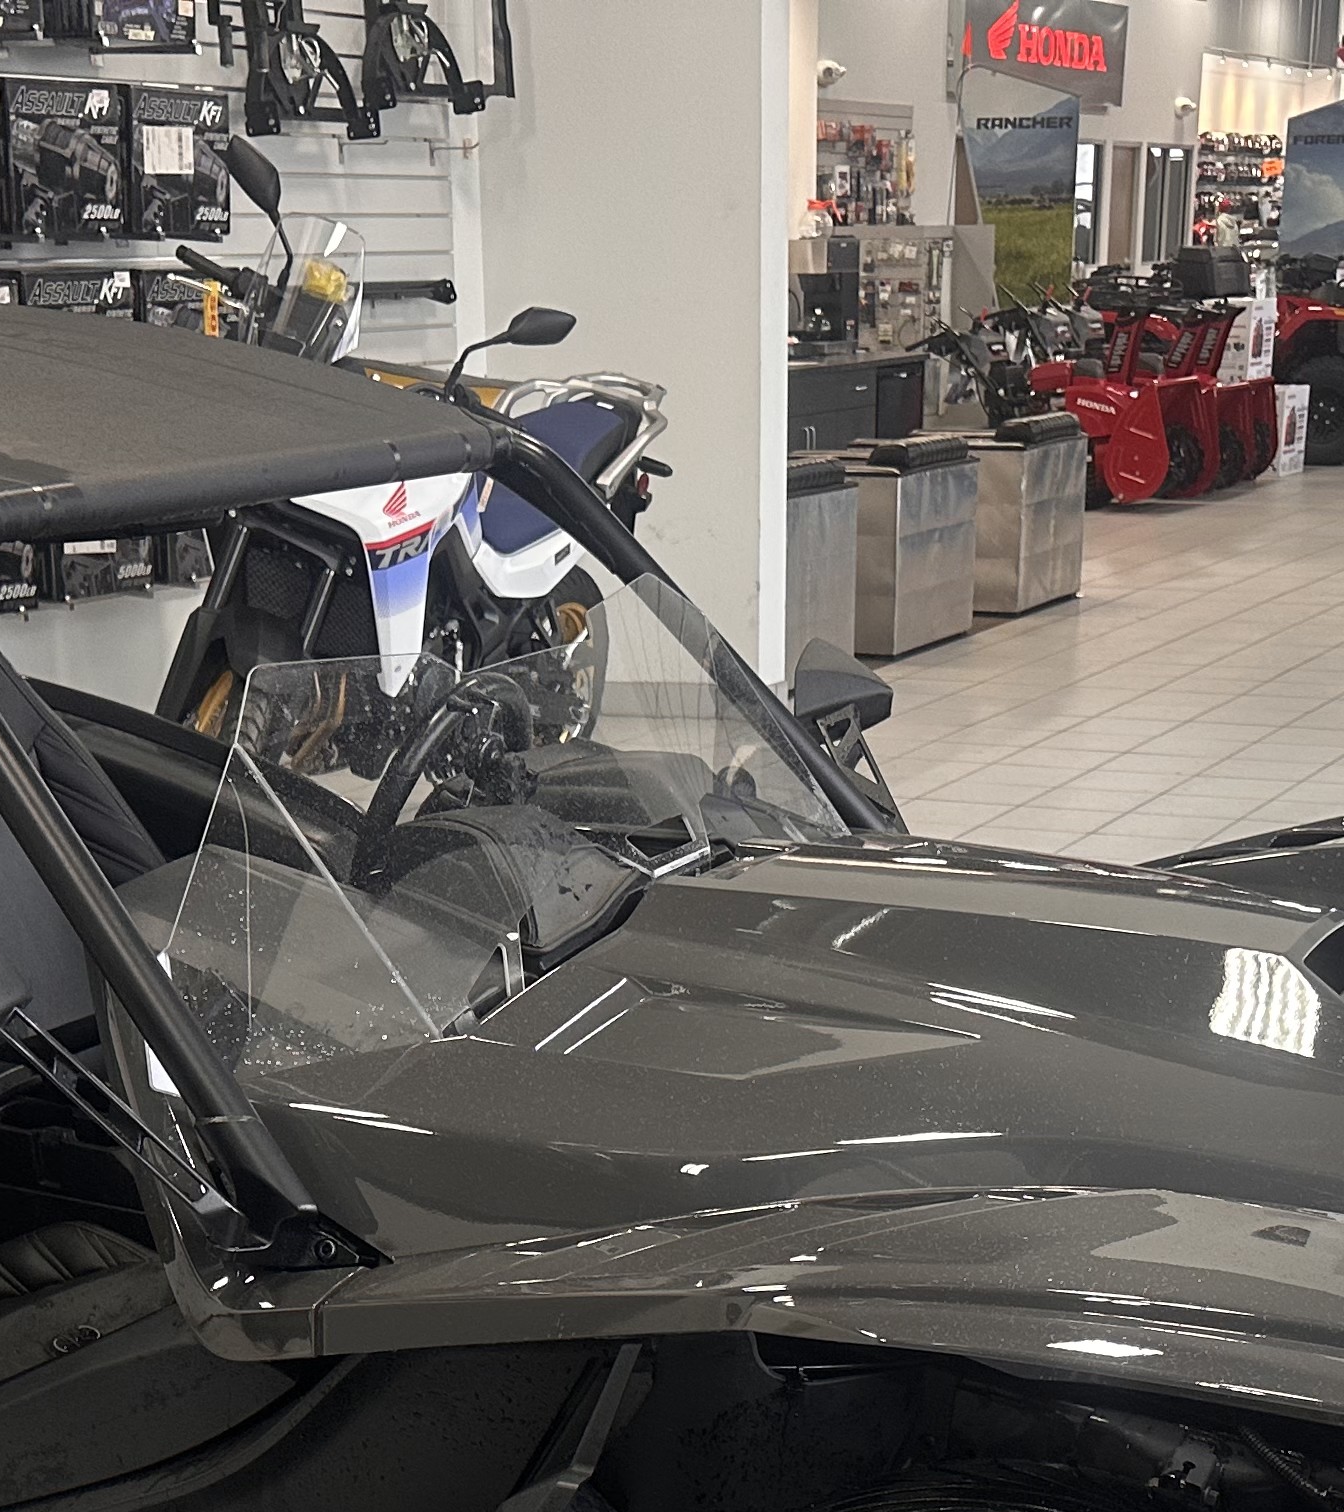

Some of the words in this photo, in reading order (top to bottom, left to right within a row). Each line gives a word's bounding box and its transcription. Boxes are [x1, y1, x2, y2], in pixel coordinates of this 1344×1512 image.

[1017, 23, 1108, 73] HONDA
[10, 85, 86, 116] ASSAULT
[133, 93, 201, 122] ASSAULT
[976, 116, 1074, 131] RANCHER
[27, 278, 101, 306] ASSAULT
[146, 276, 206, 301] ASSAU
[1076, 397, 1116, 416] HONDA
[388, 510, 421, 529] HONDA
